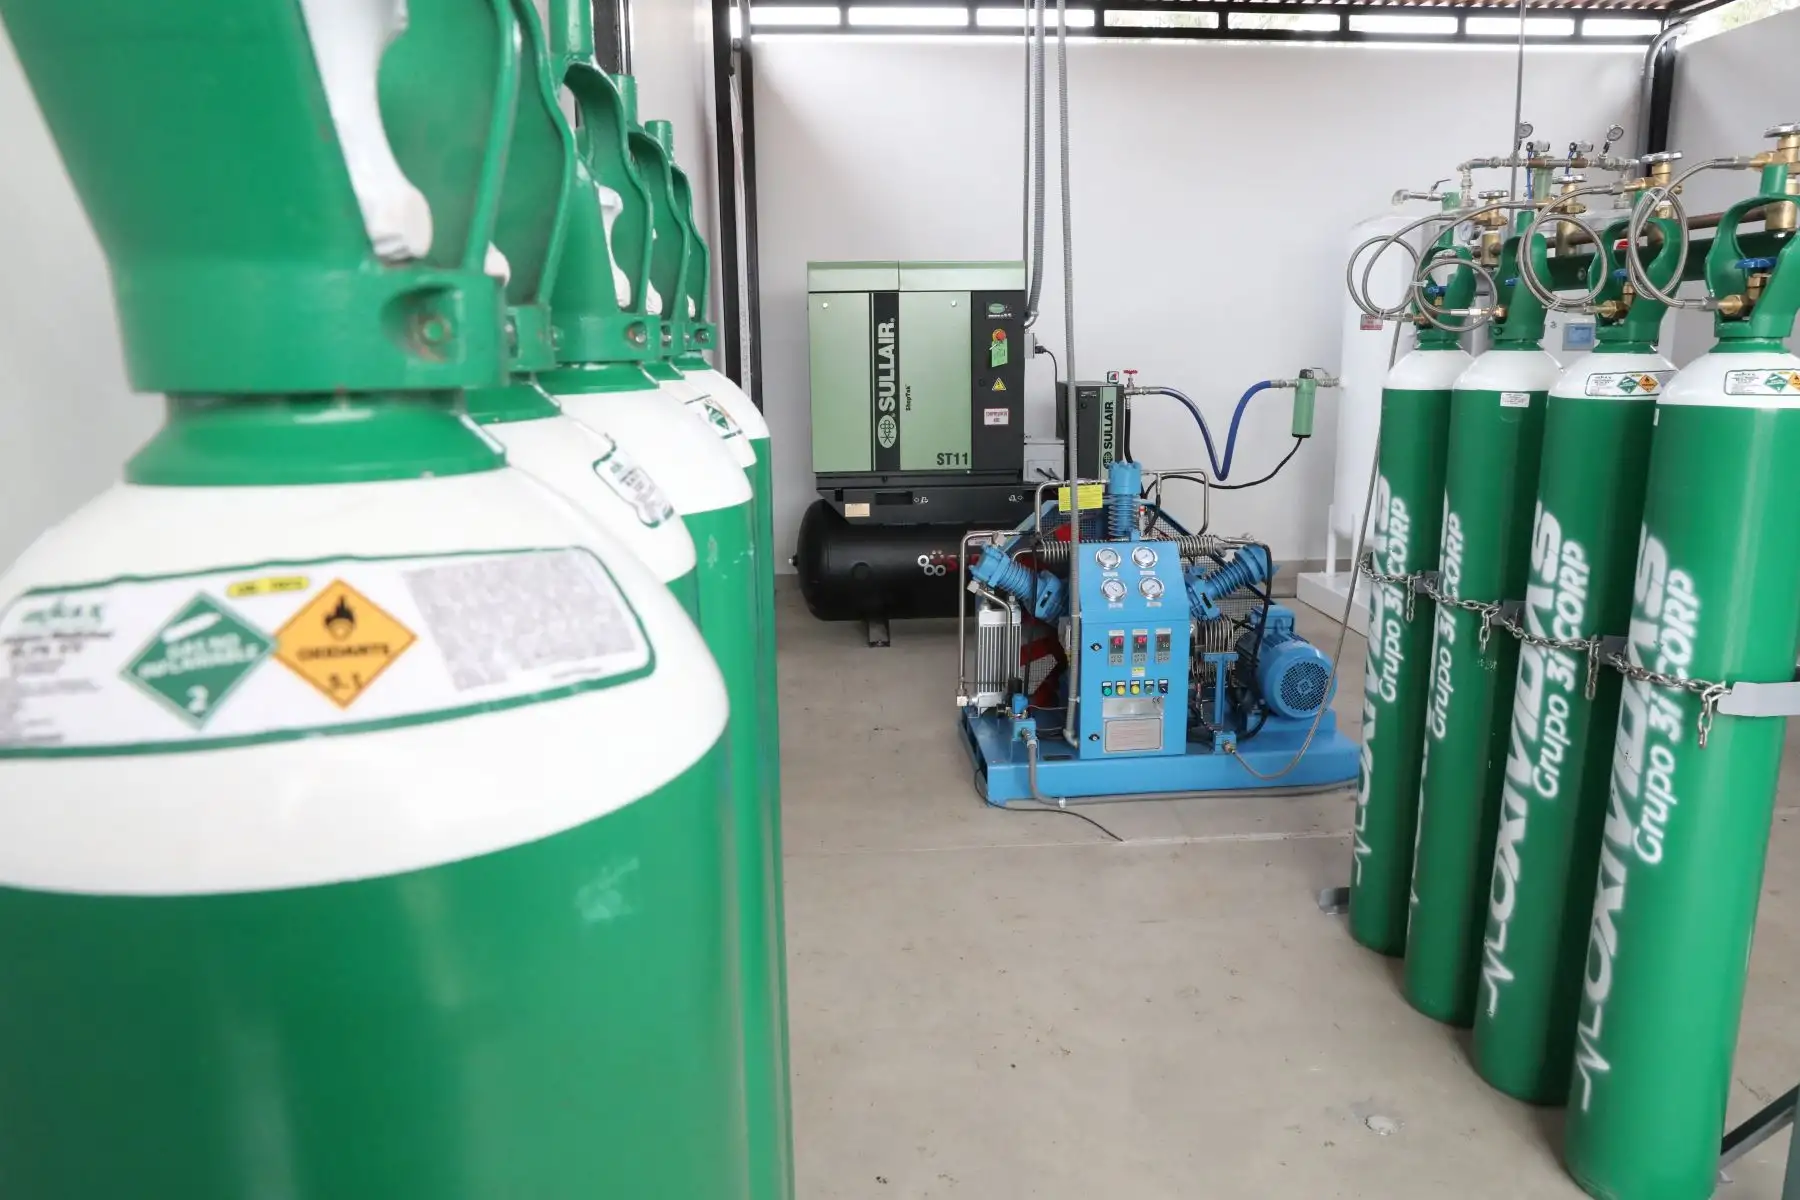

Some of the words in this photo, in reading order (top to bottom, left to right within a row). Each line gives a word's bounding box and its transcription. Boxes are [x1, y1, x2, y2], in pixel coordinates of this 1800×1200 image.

[877, 322, 896, 412] SULLAIR
[936, 452, 969, 466] ST11
[1103, 401, 1114, 450] SULLAIR
[1387, 496, 1410, 577] CORP
[1442, 511, 1464, 601] CORP
[1553, 539, 1591, 643] CORP
[1655, 568, 1701, 693] CORP
[1379, 618, 1405, 704] Grupo
[1431, 646, 1455, 740] Grupo
[1547, 648, 1577, 693] 3i
[1489, 498, 1562, 921] OXIVIDAS
[1532, 694, 1572, 799] Grupo
[1648, 688, 1684, 743] 3i
[1585, 521, 1667, 1004] OXIVIDAS
[1633, 744, 1678, 866] Grupo
